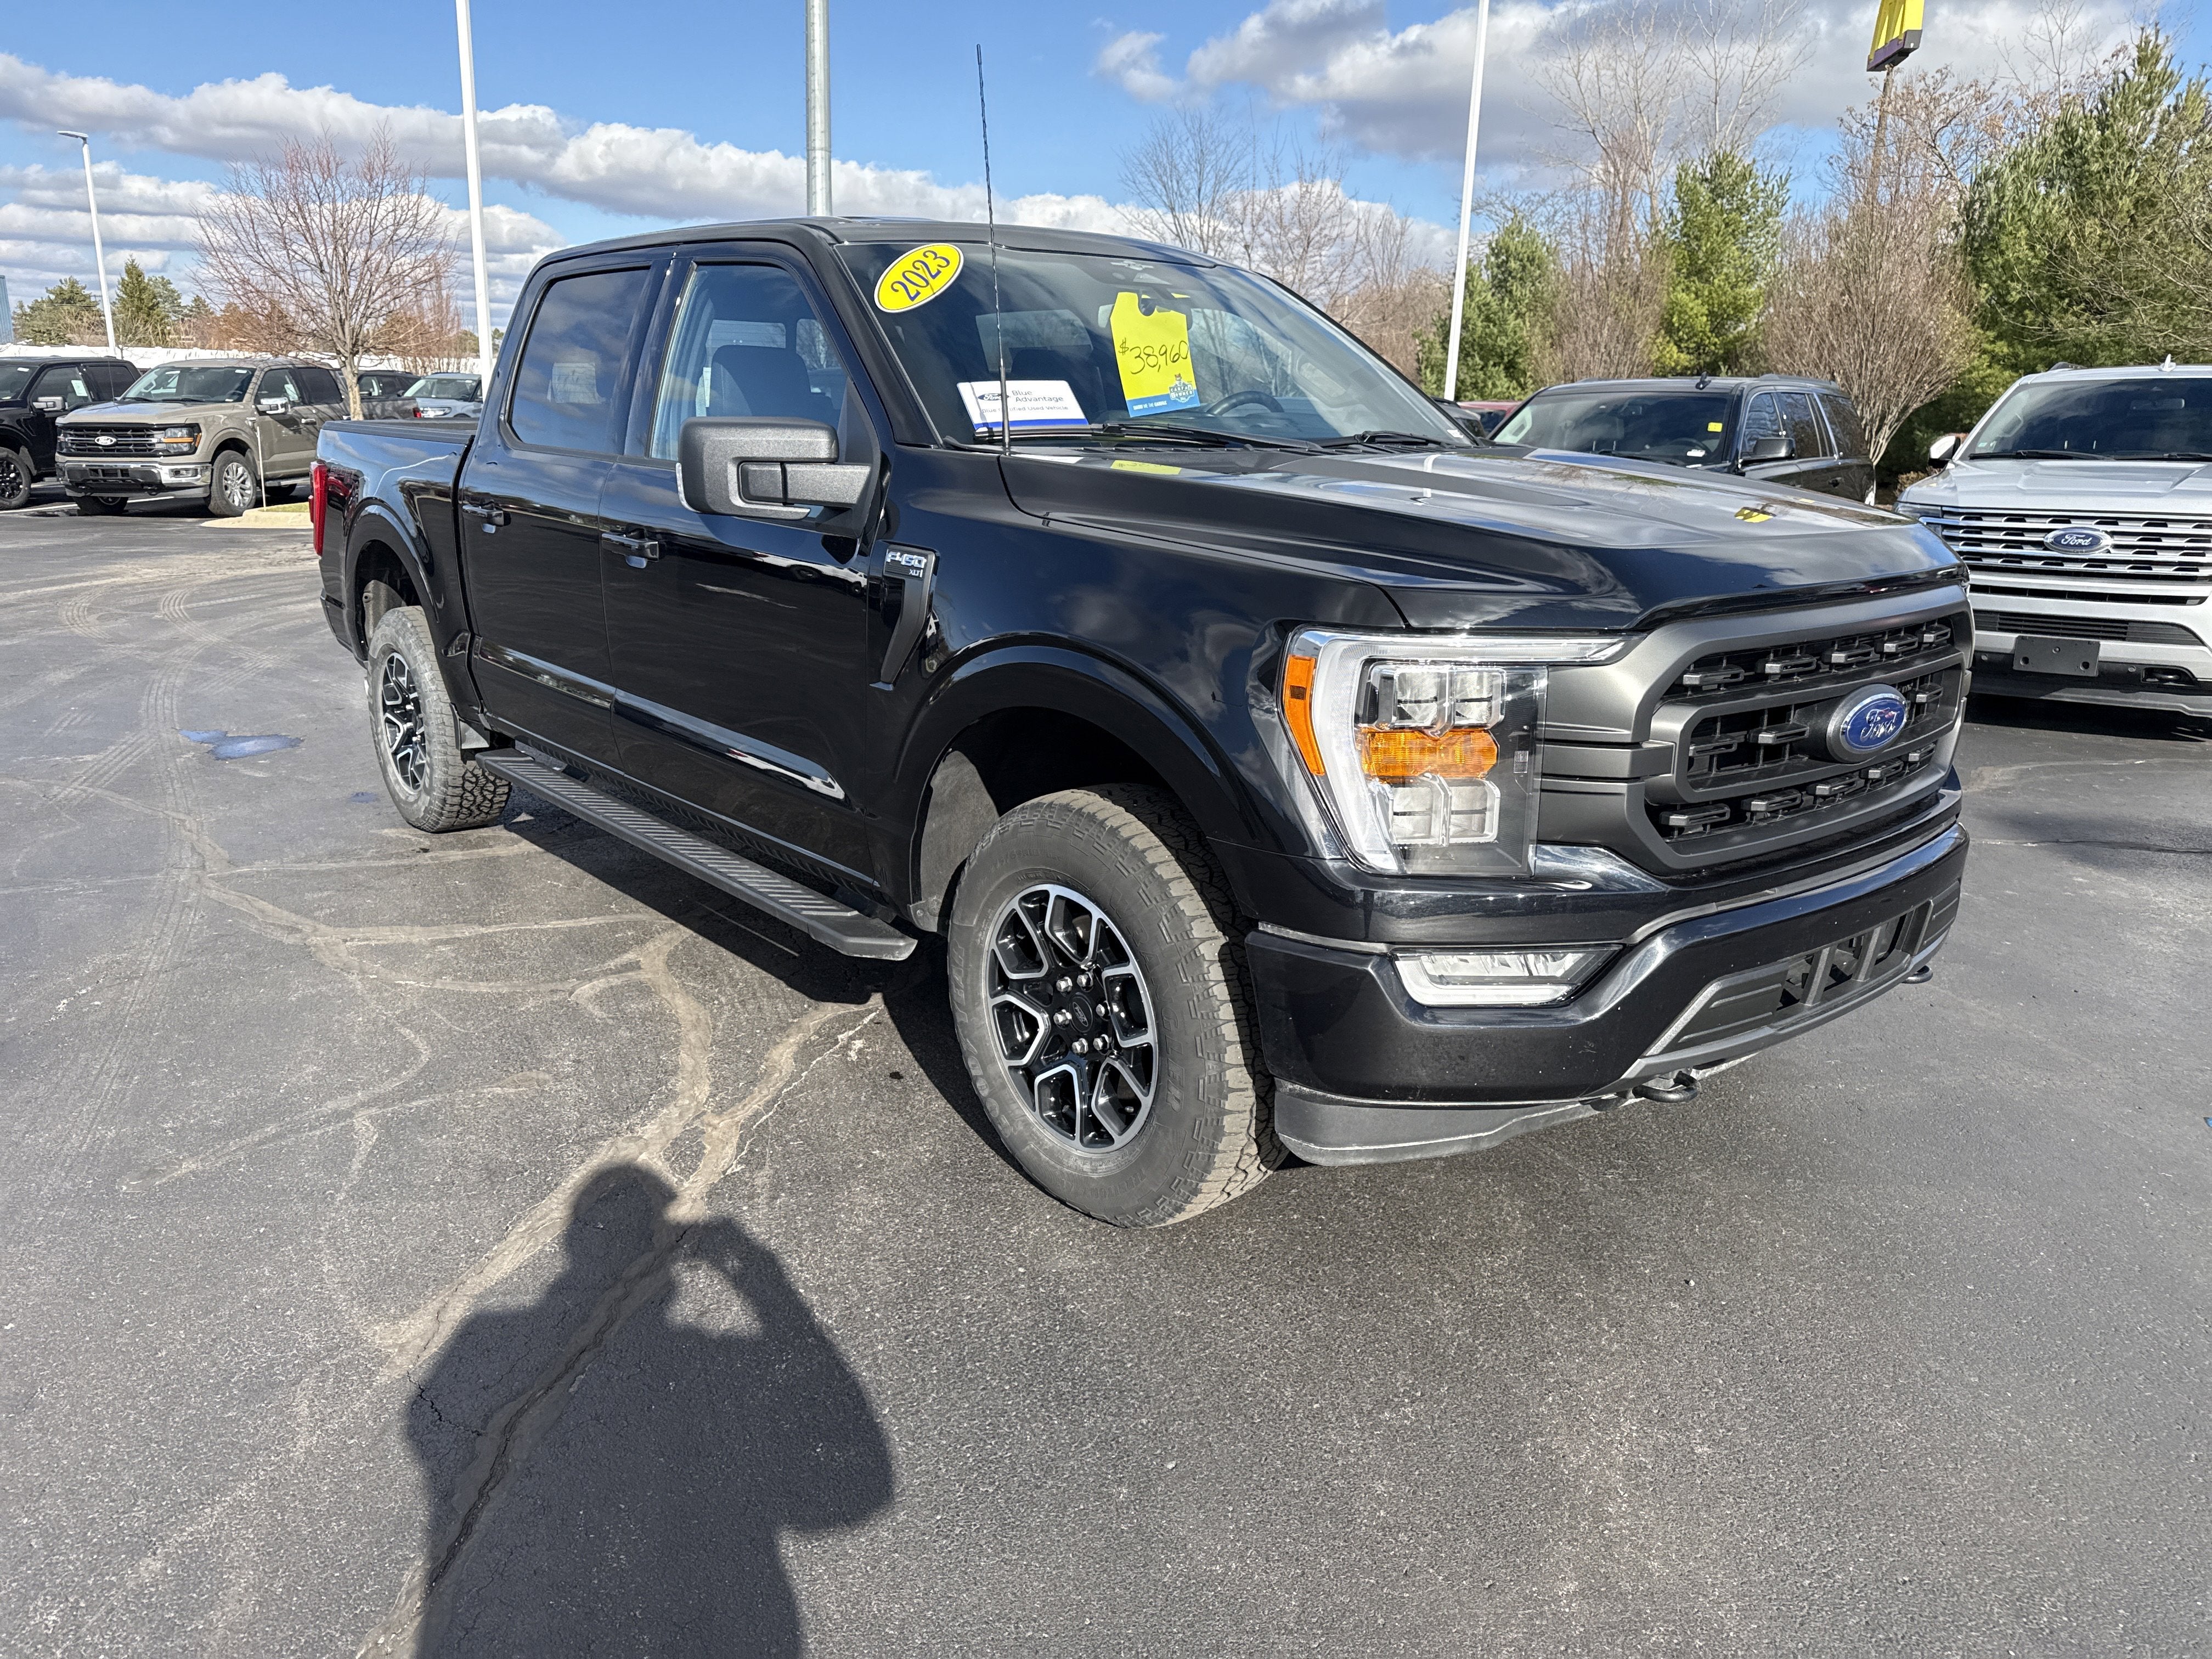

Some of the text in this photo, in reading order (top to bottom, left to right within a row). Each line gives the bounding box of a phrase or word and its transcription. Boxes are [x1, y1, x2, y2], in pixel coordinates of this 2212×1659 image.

[891, 250, 950, 302] 2023
[1118, 337, 1189, 374] $38,960
[2061, 534, 2093, 546] Ford
[1860, 707, 1900, 742] Ford
